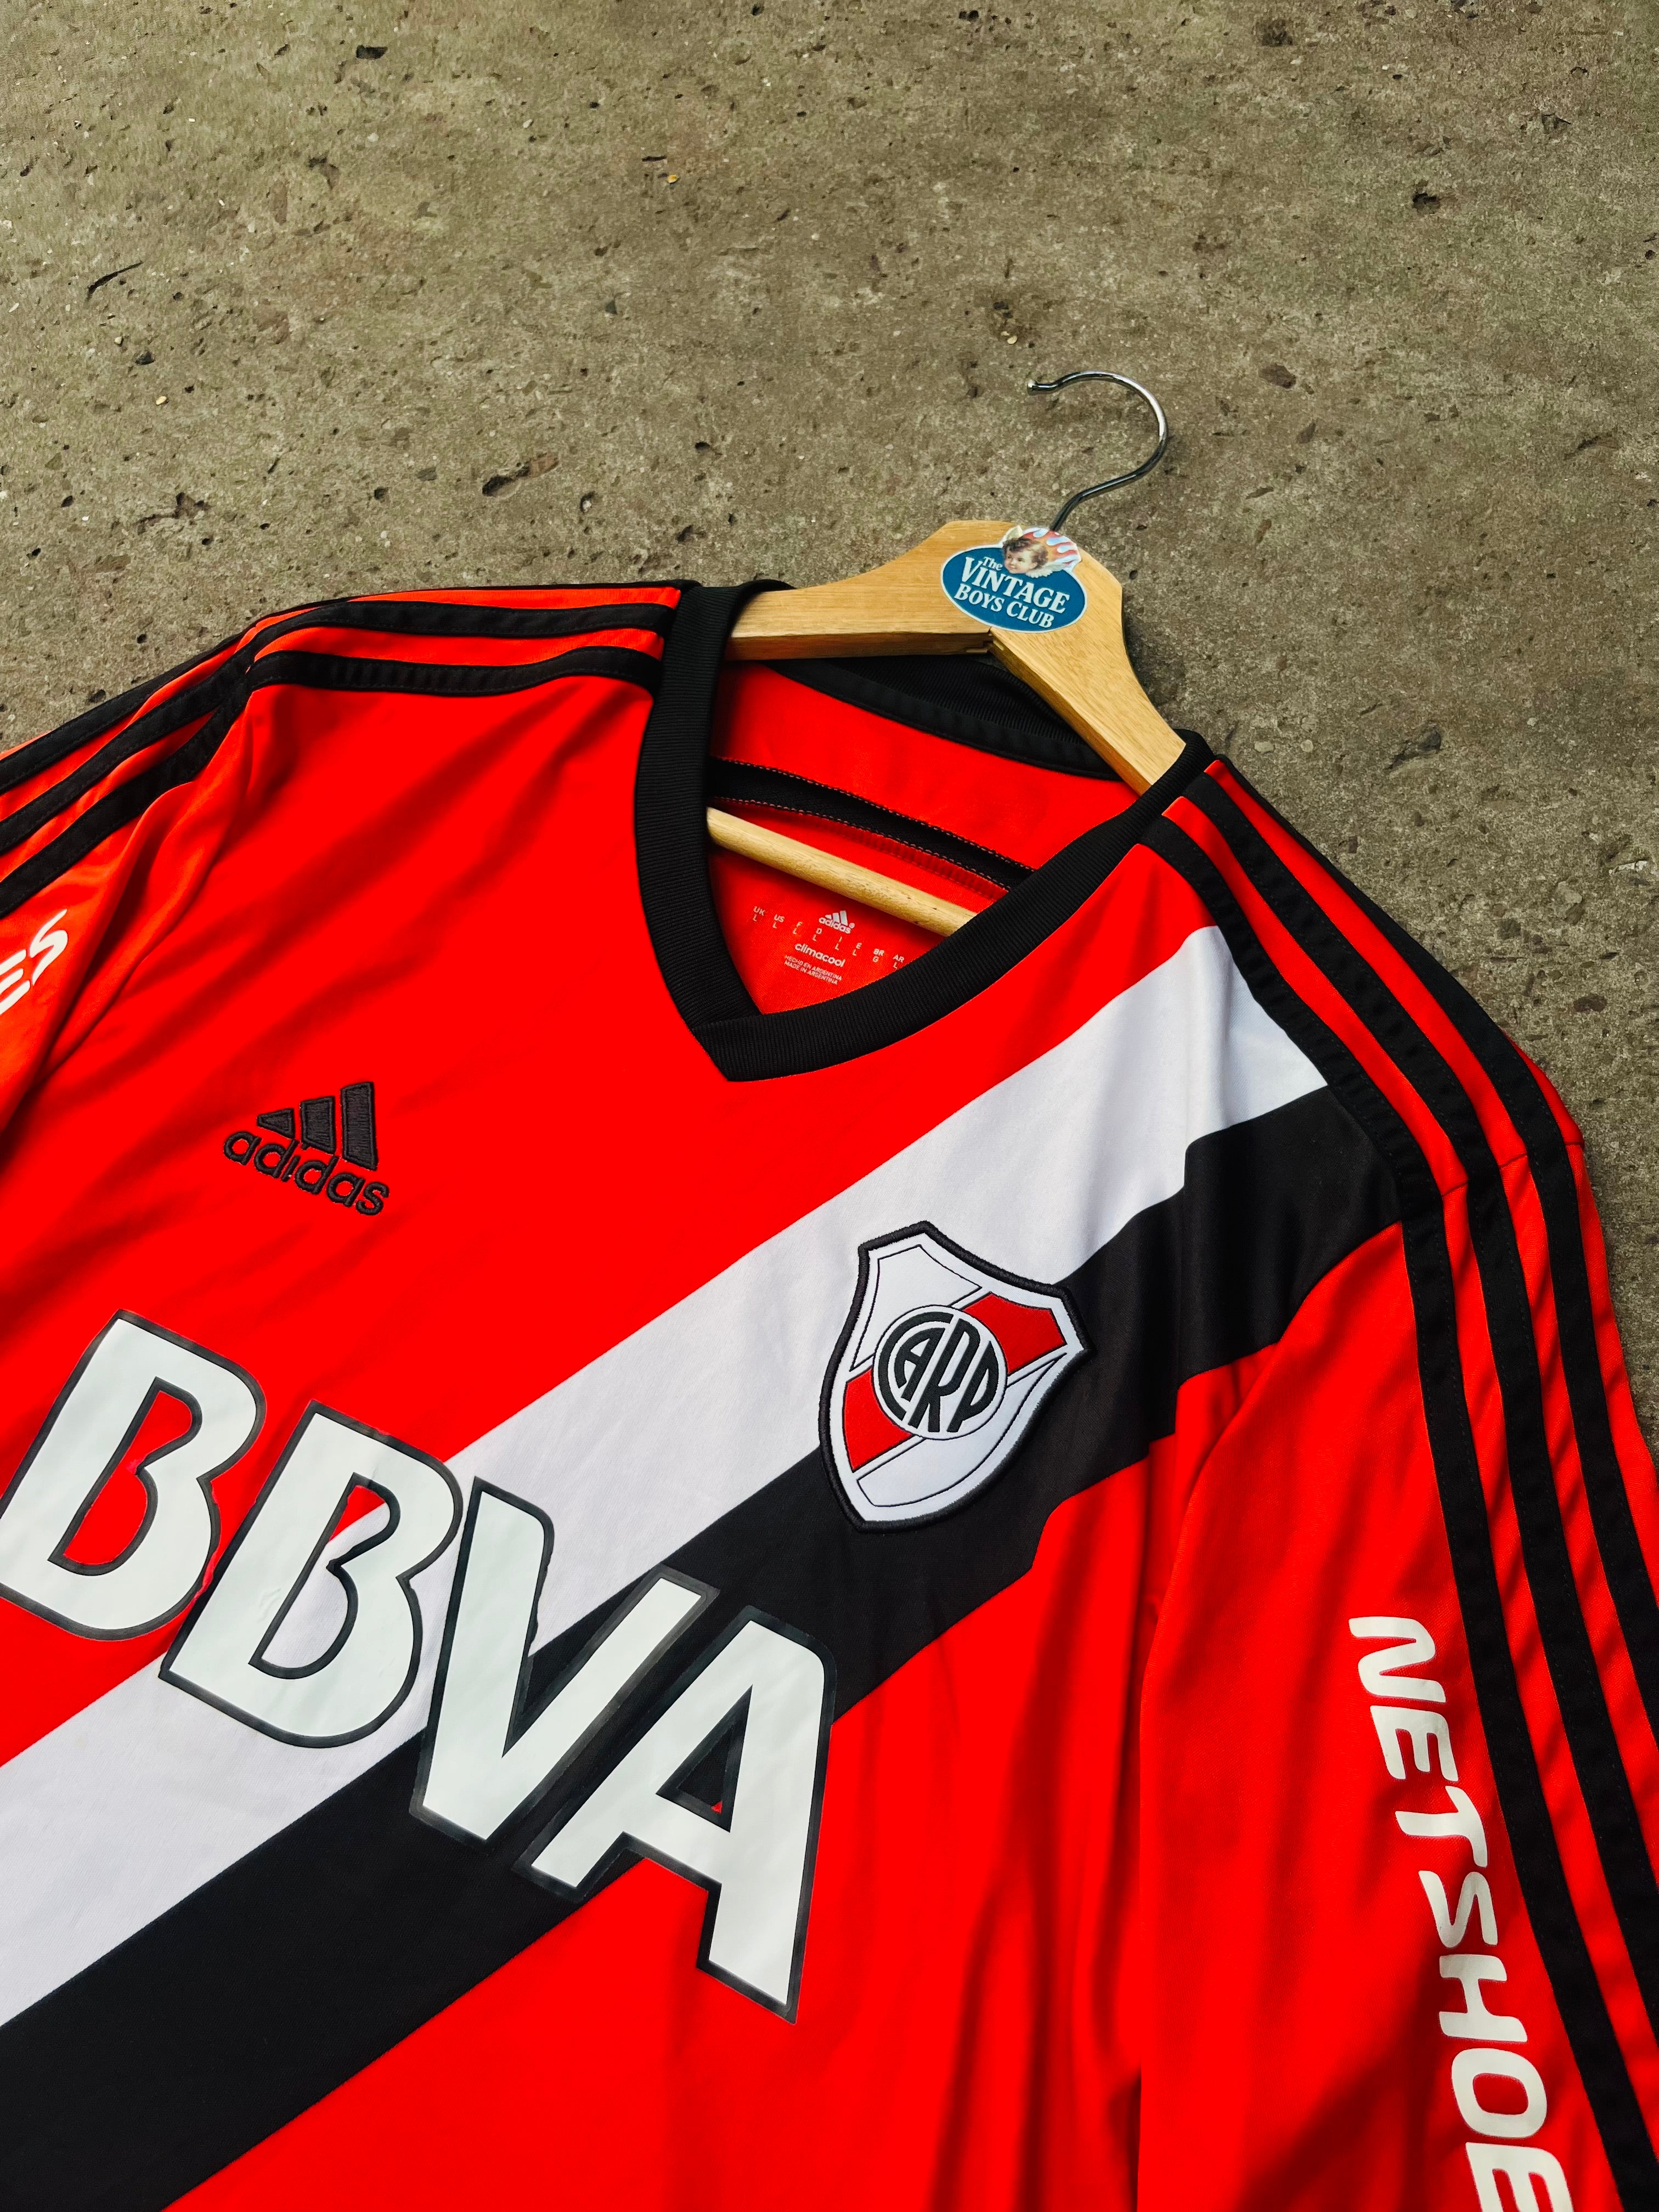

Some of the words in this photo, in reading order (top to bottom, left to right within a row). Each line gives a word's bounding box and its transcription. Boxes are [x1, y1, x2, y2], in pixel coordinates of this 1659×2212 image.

[983, 556, 1003, 571] The
[961, 557, 1070, 613] VINTAGE
[954, 583, 1005, 612] BOYS
[1006, 601, 1054, 628] CLUB
[753, 906, 765, 916] UK
[774, 915, 785, 923] US
[873, 948, 885, 956] BR
[893, 954, 905, 963] AR
[819, 917, 851, 934] adidas
[784, 961, 800, 971] MADE
[806, 969, 838, 985] ARGENTINA
[795, 943, 845, 968] climacool
[803, 962, 812, 970] EN
[811, 964, 843, 981] ARGENTINA
[223, 1131, 389, 1215] adidas
[0, 1310, 837, 2024] BBVA
